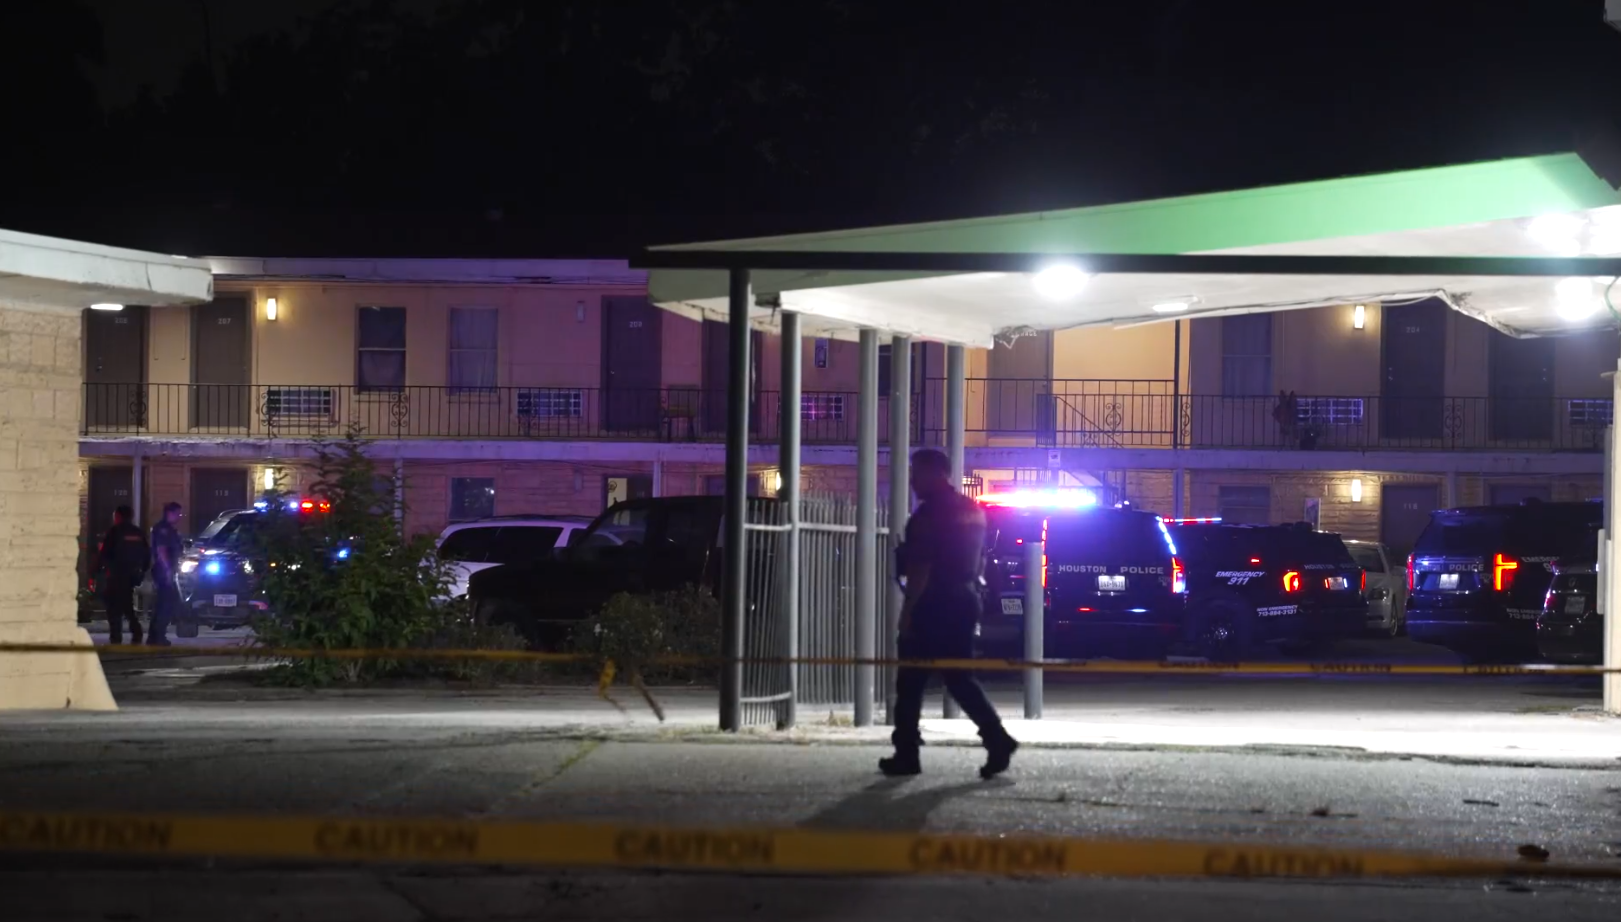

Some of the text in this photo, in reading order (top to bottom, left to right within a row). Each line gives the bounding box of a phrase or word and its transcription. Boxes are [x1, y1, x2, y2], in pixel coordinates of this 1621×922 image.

[217, 317, 231, 325] 207
[1058, 565, 1164, 574] HOUSTON POLICE
[1449, 564, 1485, 572] POLICE
[1227, 577, 1250, 586] 911
[1, 815, 1364, 878] CAUTION CAUTION CAUTION CAUTION CAUTION
